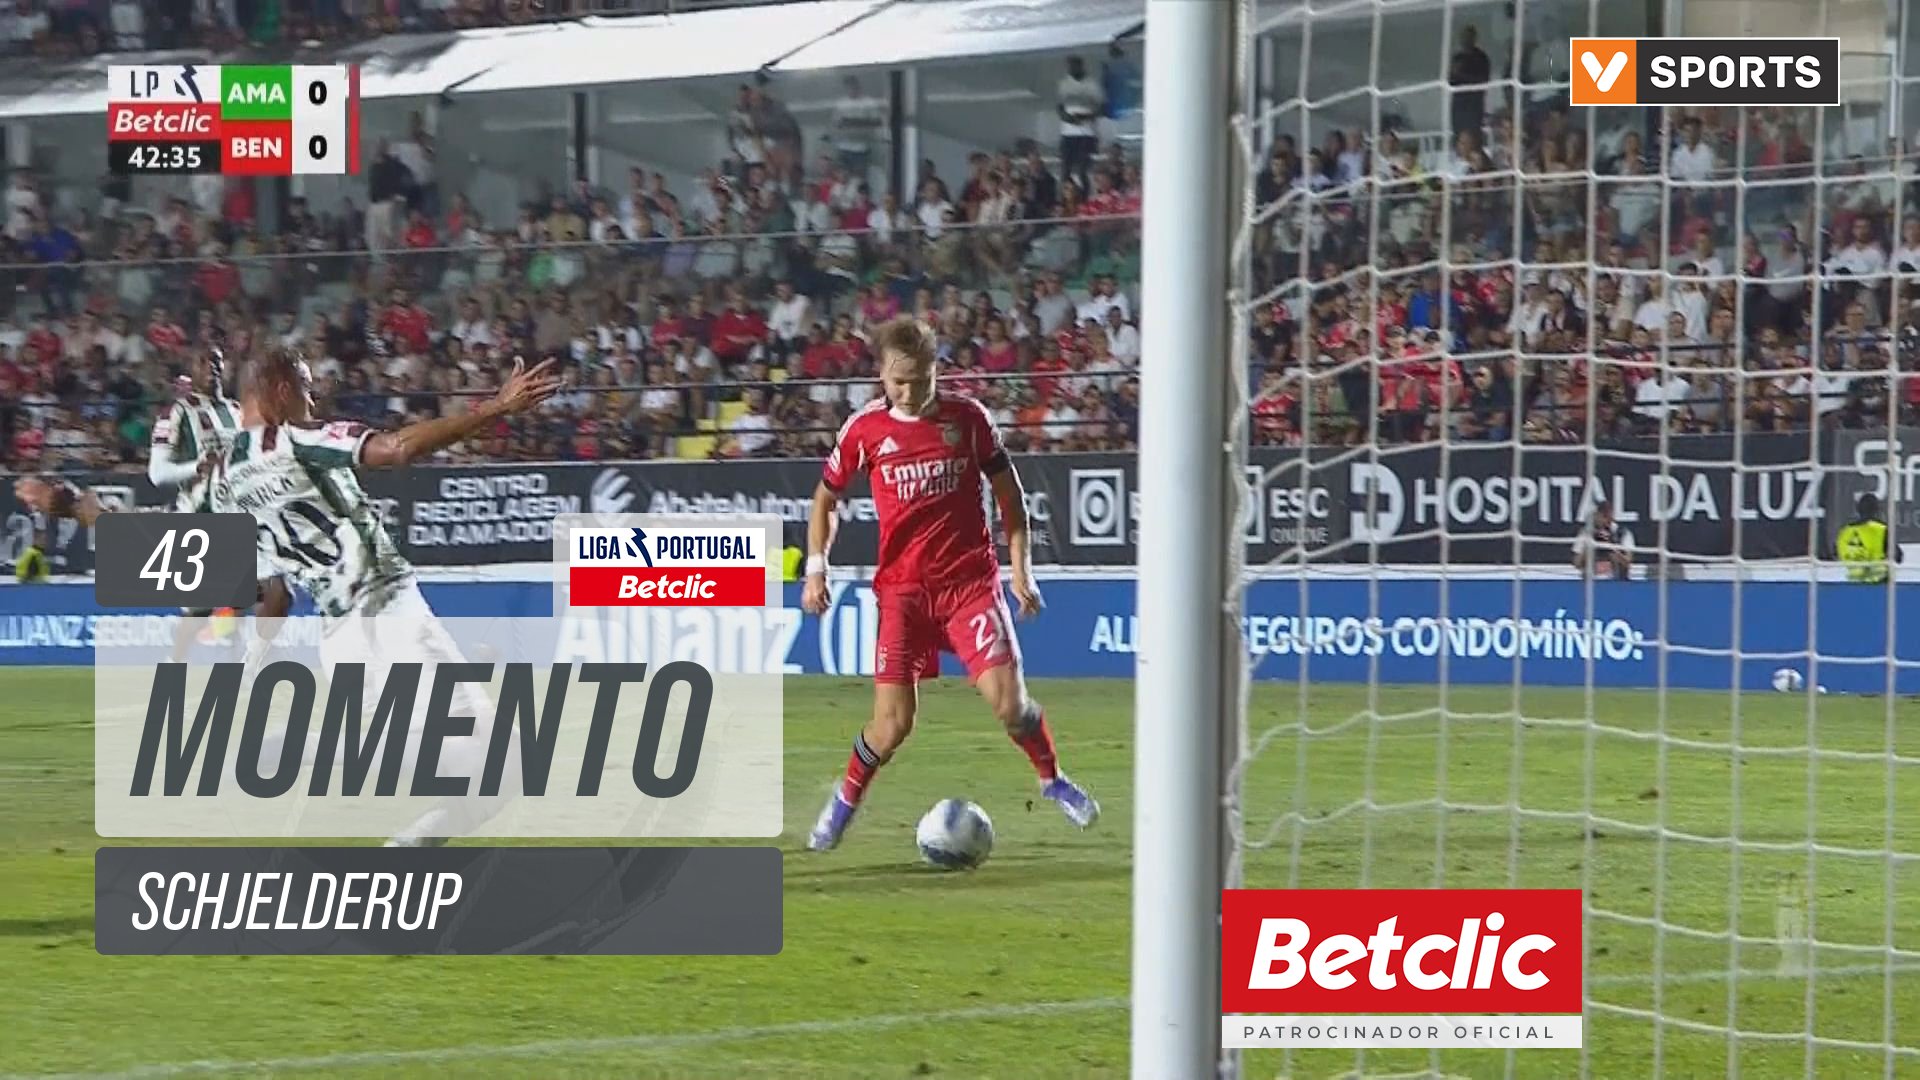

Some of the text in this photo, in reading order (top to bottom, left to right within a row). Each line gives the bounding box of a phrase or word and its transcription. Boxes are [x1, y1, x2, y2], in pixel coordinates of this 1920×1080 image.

[439, 473, 548, 498] CENTRO
[1414, 474, 1639, 523] HOSPITAL
[1649, 473, 1719, 521] DA
[1732, 470, 1826, 520] LUZ
[412, 495, 581, 523] RECICLAGEM
[1269, 486, 1329, 518] ESC
[407, 524, 449, 546] DA
[1242, 616, 1383, 656] EGUROS
[1391, 609, 1643, 660] CONDOMÍNIO:
